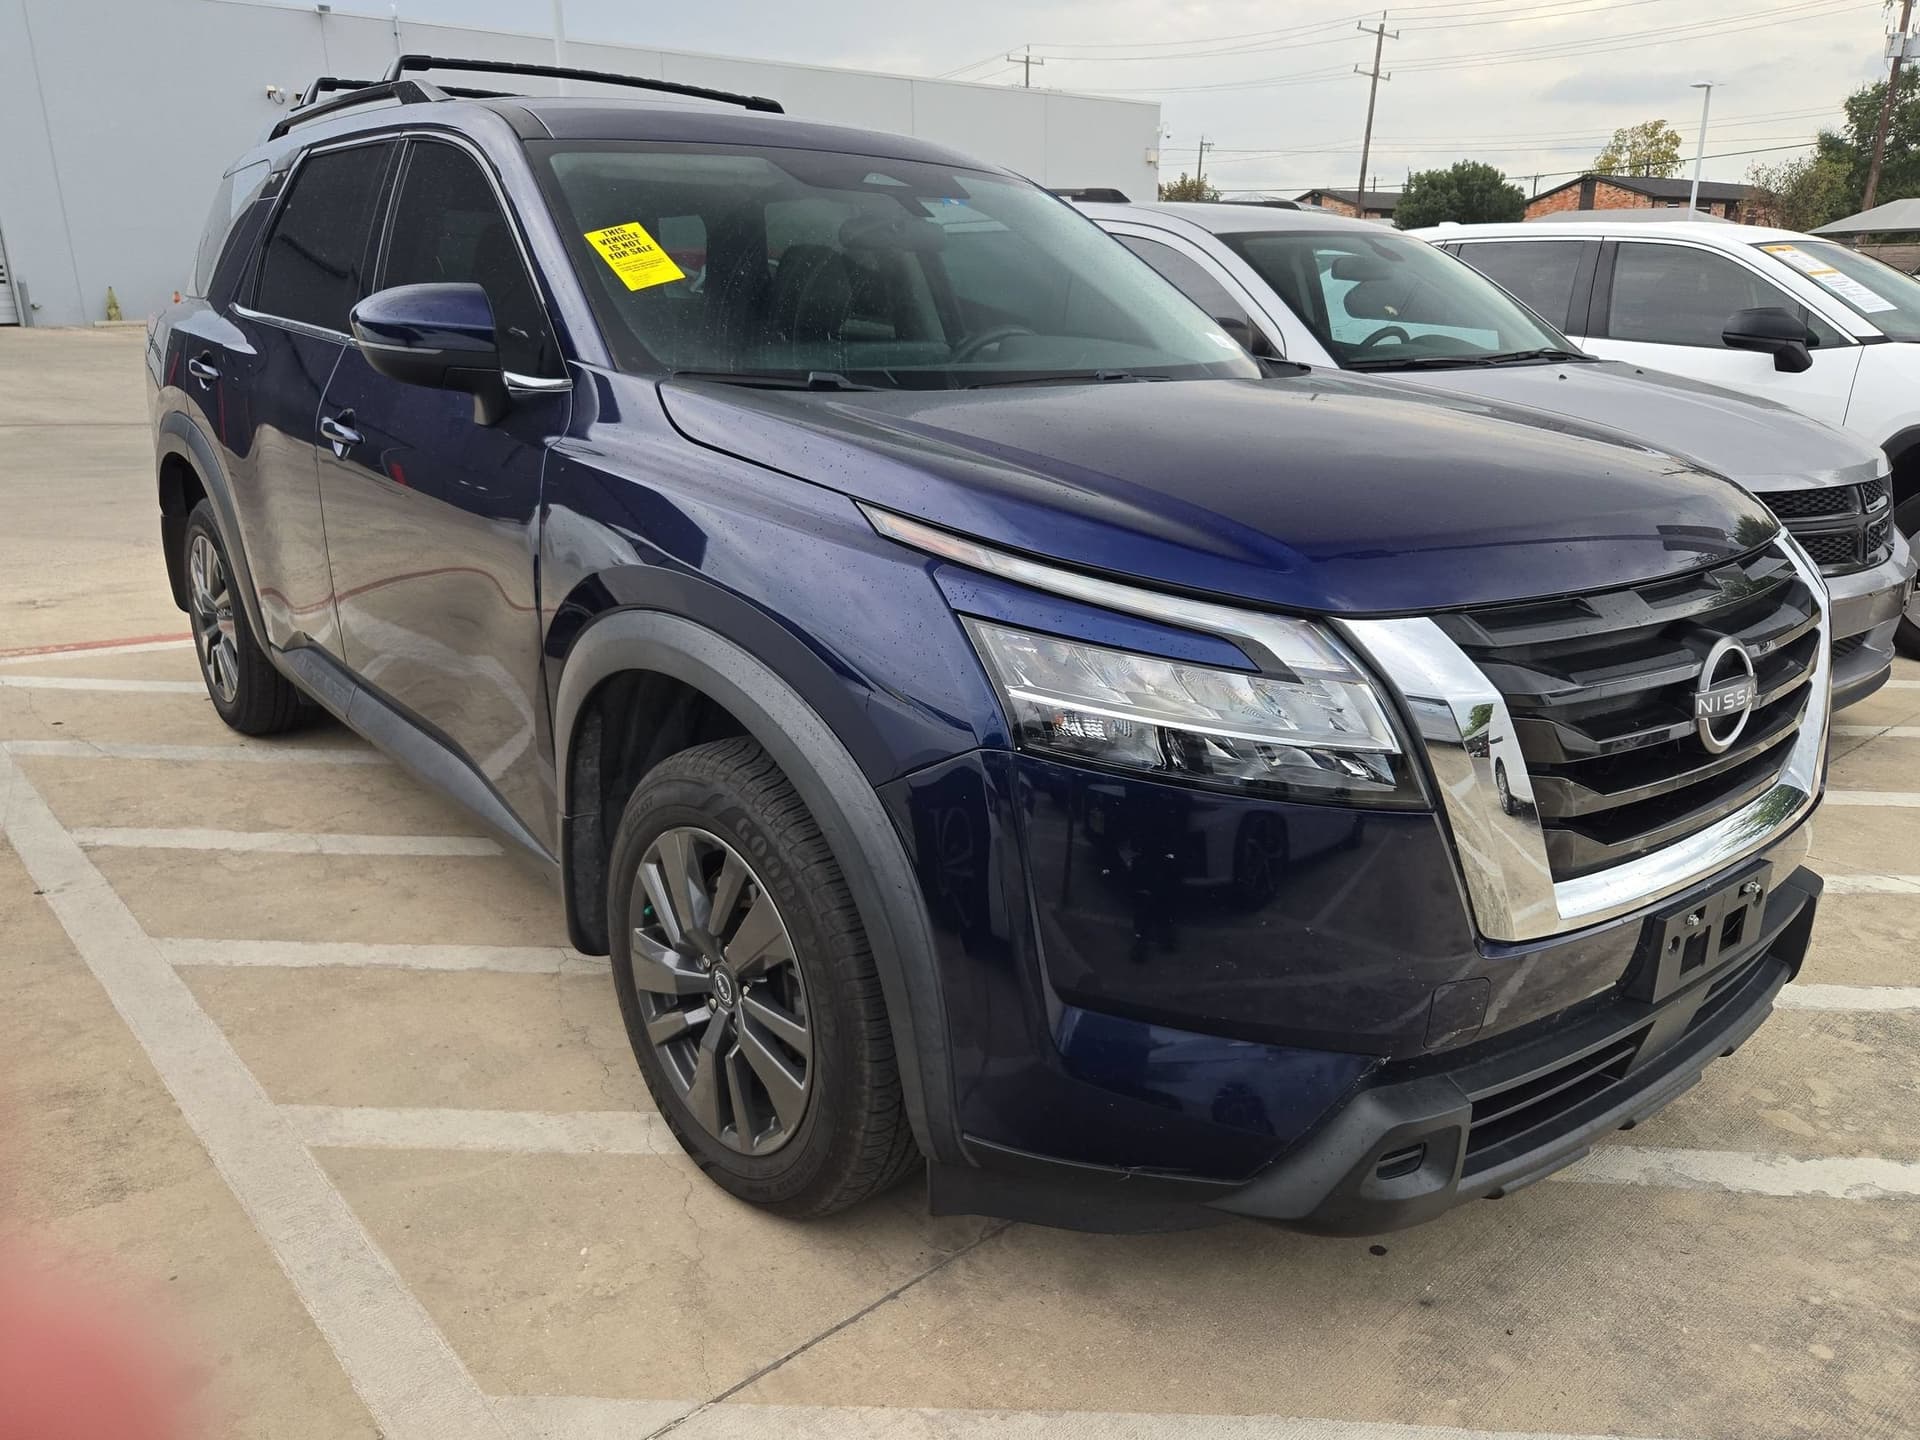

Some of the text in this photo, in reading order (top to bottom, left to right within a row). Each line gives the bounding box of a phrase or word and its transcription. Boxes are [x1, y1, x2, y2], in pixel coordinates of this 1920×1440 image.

[599, 232, 641, 246] VEHICLE
[601, 227, 626, 238] THIS
[608, 244, 654, 260] FOR SALE
[609, 239, 642, 252] IS NOT
[1698, 686, 1754, 715] NISSA
